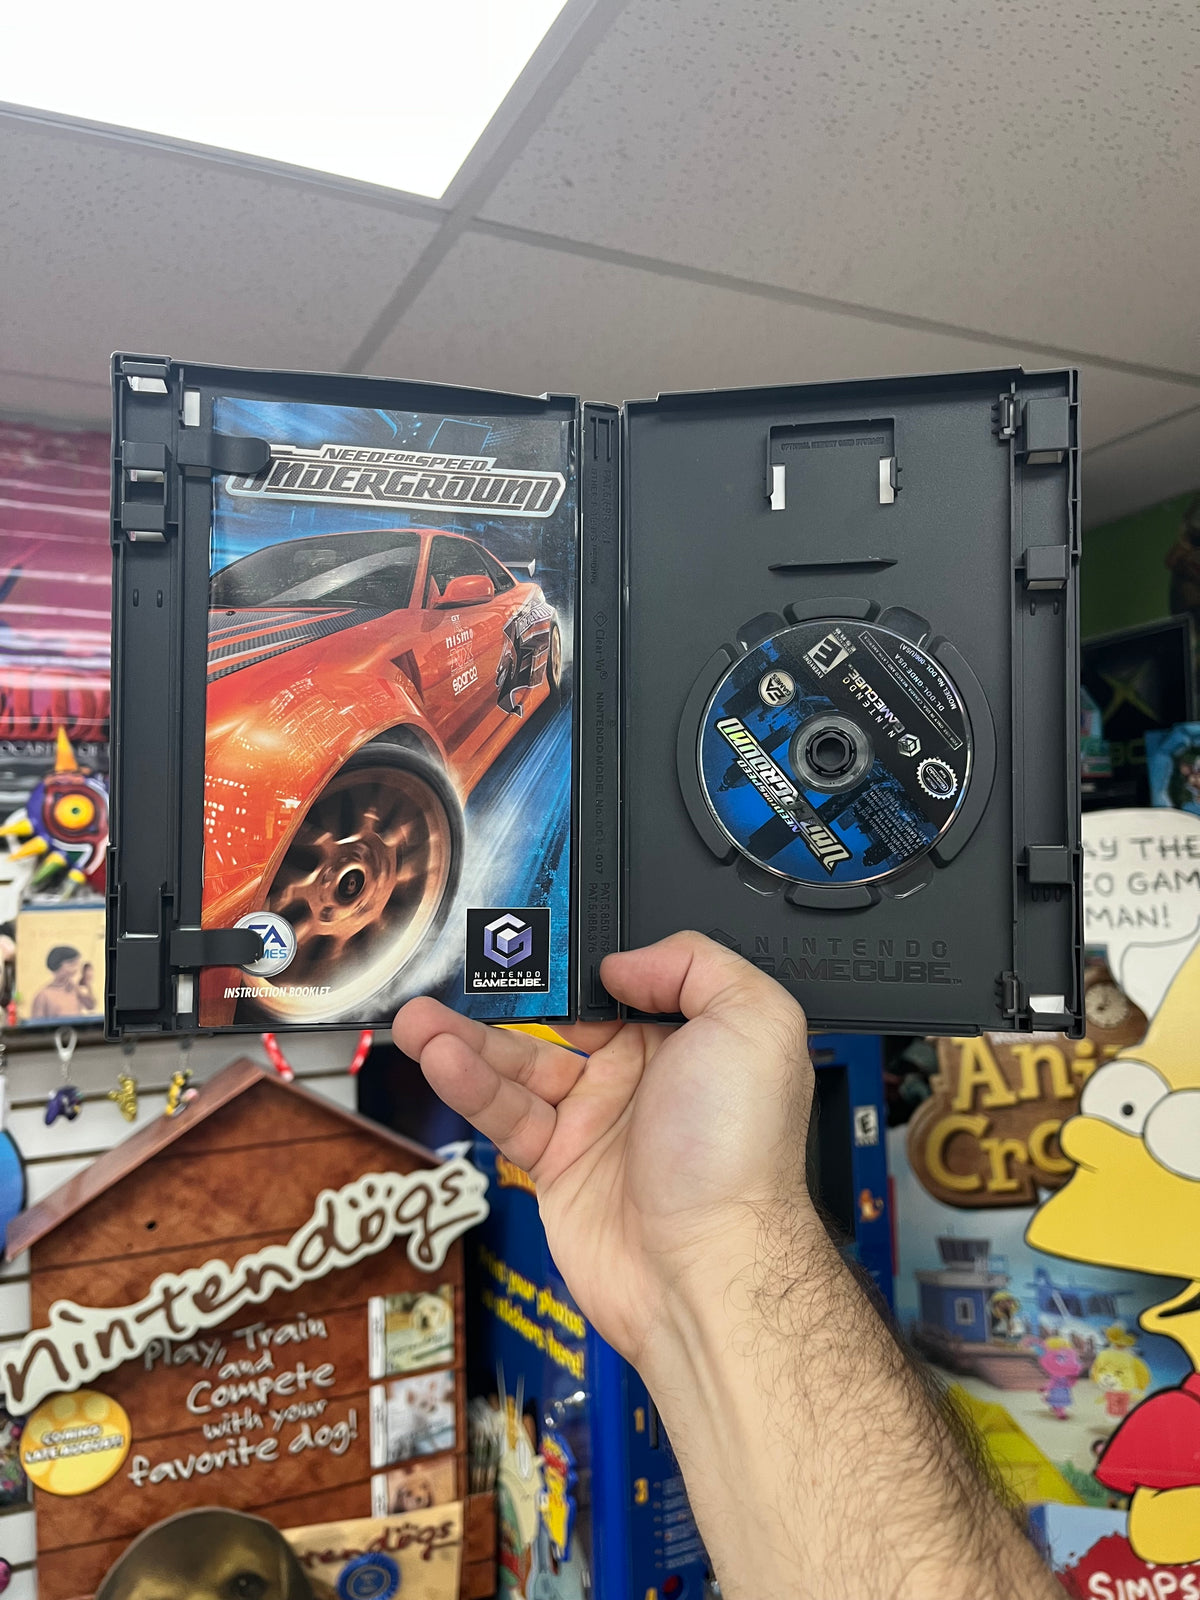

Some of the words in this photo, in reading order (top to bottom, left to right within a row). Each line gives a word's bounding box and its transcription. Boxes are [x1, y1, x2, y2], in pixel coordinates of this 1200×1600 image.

[322, 447, 386, 462] NEED
[383, 453, 418, 463] FOR
[416, 456, 489, 472] SPEED
[761, 678, 786, 704] EA
[771, 673, 792, 697] GAMES
[943, 687, 956, 709] MODEL
[842, 676, 896, 739] NINTENDO
[717, 717, 850, 867] UNDRGROUND
[1128, 835, 1200, 860] THE
[755, 935, 949, 959] NINTENDO
[474, 970, 541, 978] NINTENDO
[223, 986, 287, 998] INSTRUCTION
[288, 986, 331, 997] BOOKLET
[233, 1311, 328, 1350] Train
[218, 1350, 275, 1380] and
[186, 1360, 336, 1415] Compete
[203, 1406, 264, 1441] with
[269, 1399, 329, 1432] your
[127, 1436, 280, 1487] favorite
[288, 1408, 359, 1455] dog!
